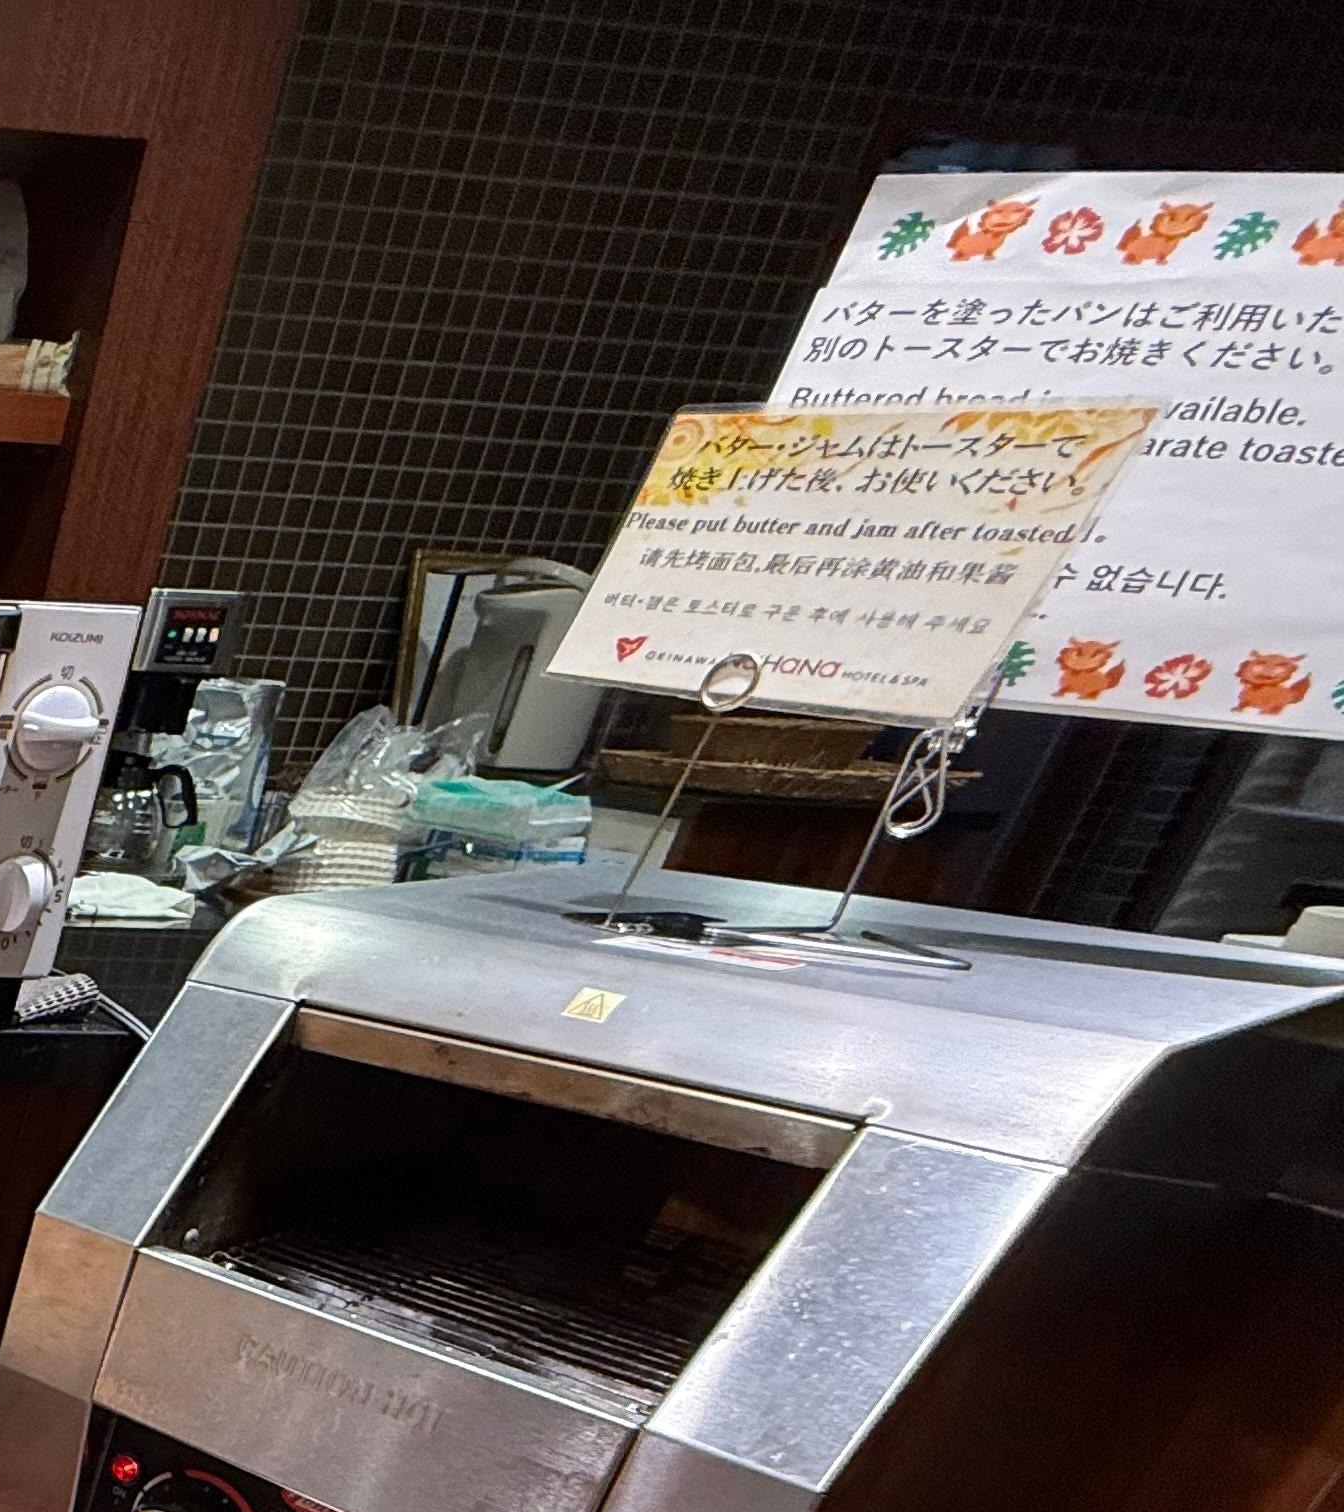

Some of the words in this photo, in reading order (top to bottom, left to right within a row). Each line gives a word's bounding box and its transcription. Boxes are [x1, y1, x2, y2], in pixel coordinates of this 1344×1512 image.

[822, 298, 1343, 334] バターを塗ったパンはご利用いた
[802, 334, 1333, 376] 別のトースターでお焼きください。
[697, 433, 1088, 459] バター・ジャムはトースターで
[1238, 436, 1344, 468] toaste
[668, 466, 1085, 497] 焼き上げた後、お使いください。
[625, 511, 688, 531] Please
[691, 515, 728, 534] put
[733, 514, 801, 536] butter
[803, 518, 850, 537] and
[851, 518, 897, 540] jam
[903, 520, 968, 541] after
[1086, 564, 1227, 600] 없습니다.
[49, 631, 104, 645] KOIZUMI
[54, 889, 63, 903] 5
